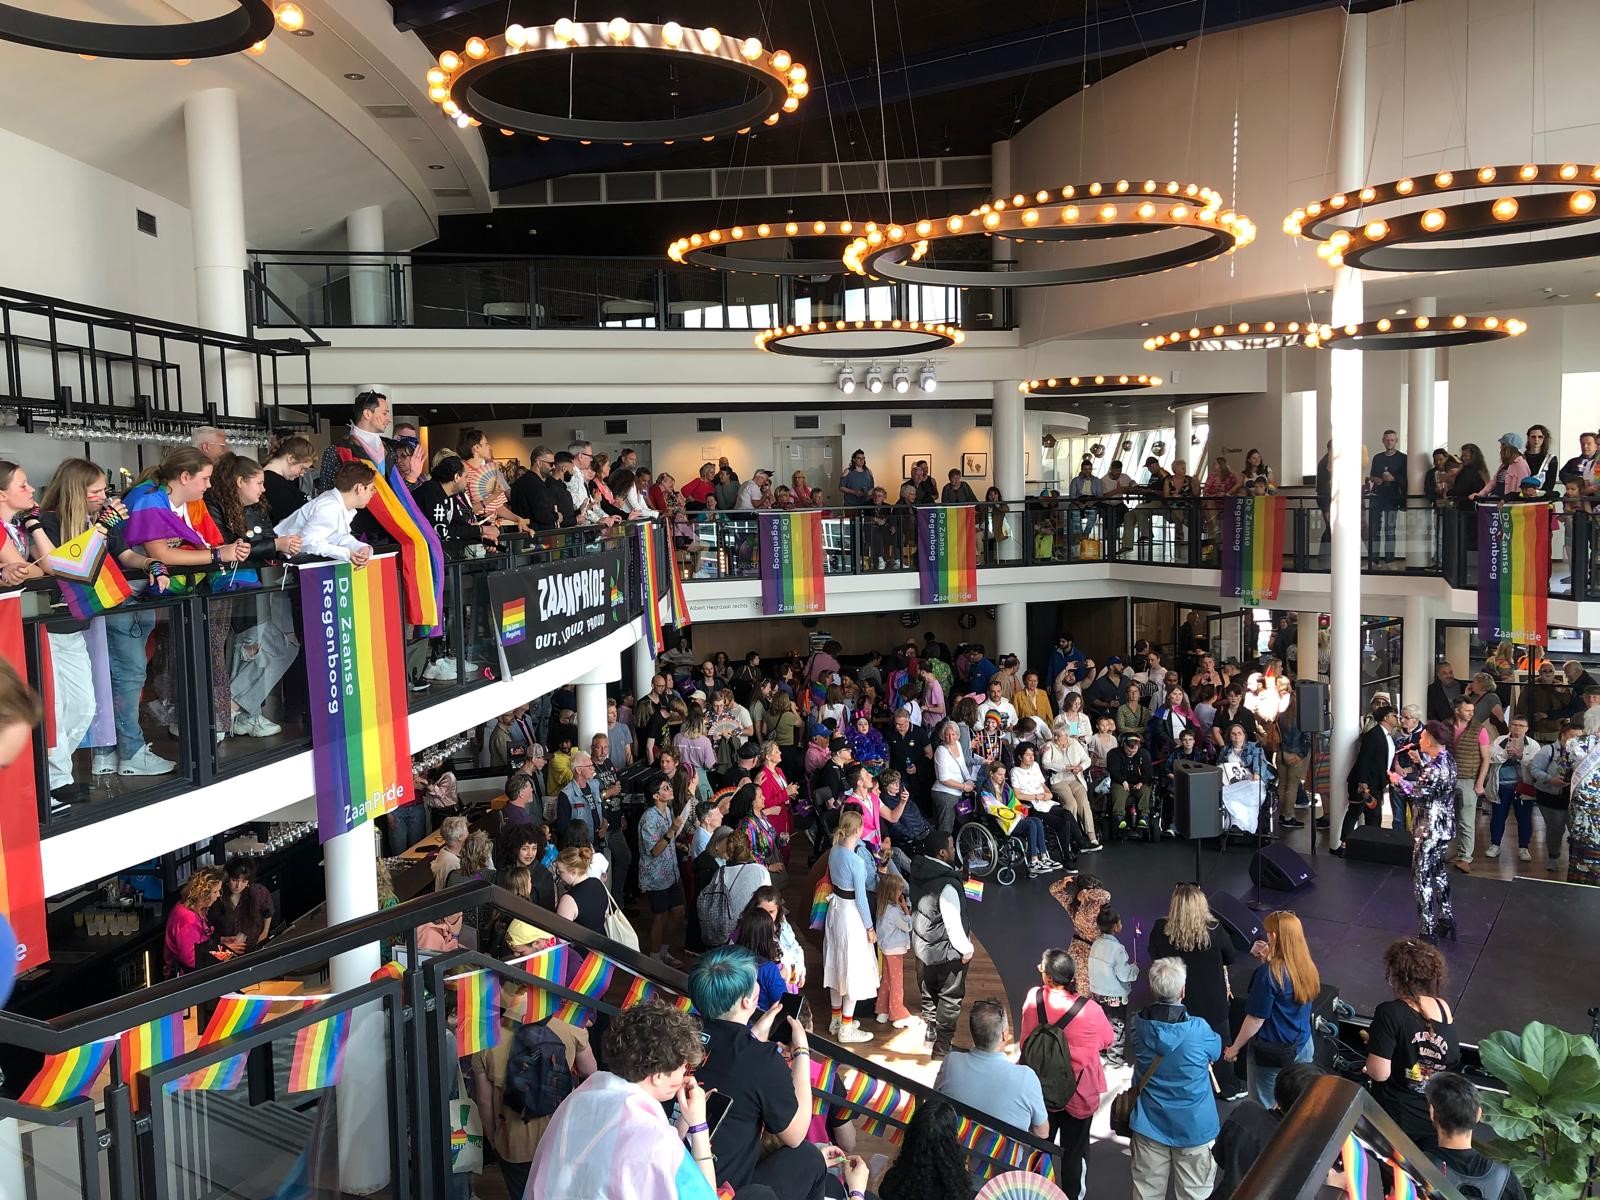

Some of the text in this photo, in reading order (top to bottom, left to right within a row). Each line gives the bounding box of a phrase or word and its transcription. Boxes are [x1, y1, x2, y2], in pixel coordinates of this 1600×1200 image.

[1232, 498, 1243, 551] Regenboog
[1244, 498, 1253, 511] De
[770, 519, 780, 569] Regenboog
[781, 518, 790, 564] De Zaanse
[928, 513, 937, 561] Regenboog
[1501, 512, 1511, 574] De Zaanse
[537, 568, 605, 622] ZAANPRIDE
[778, 602, 819, 612] Zaanide
[933, 591, 972, 602] Zaaide
[1234, 587, 1273, 597] Zaanide
[322, 579, 339, 714] Regenboog
[339, 577, 354, 696] De Zaanse
[344, 783, 404, 825] ZaanPride
